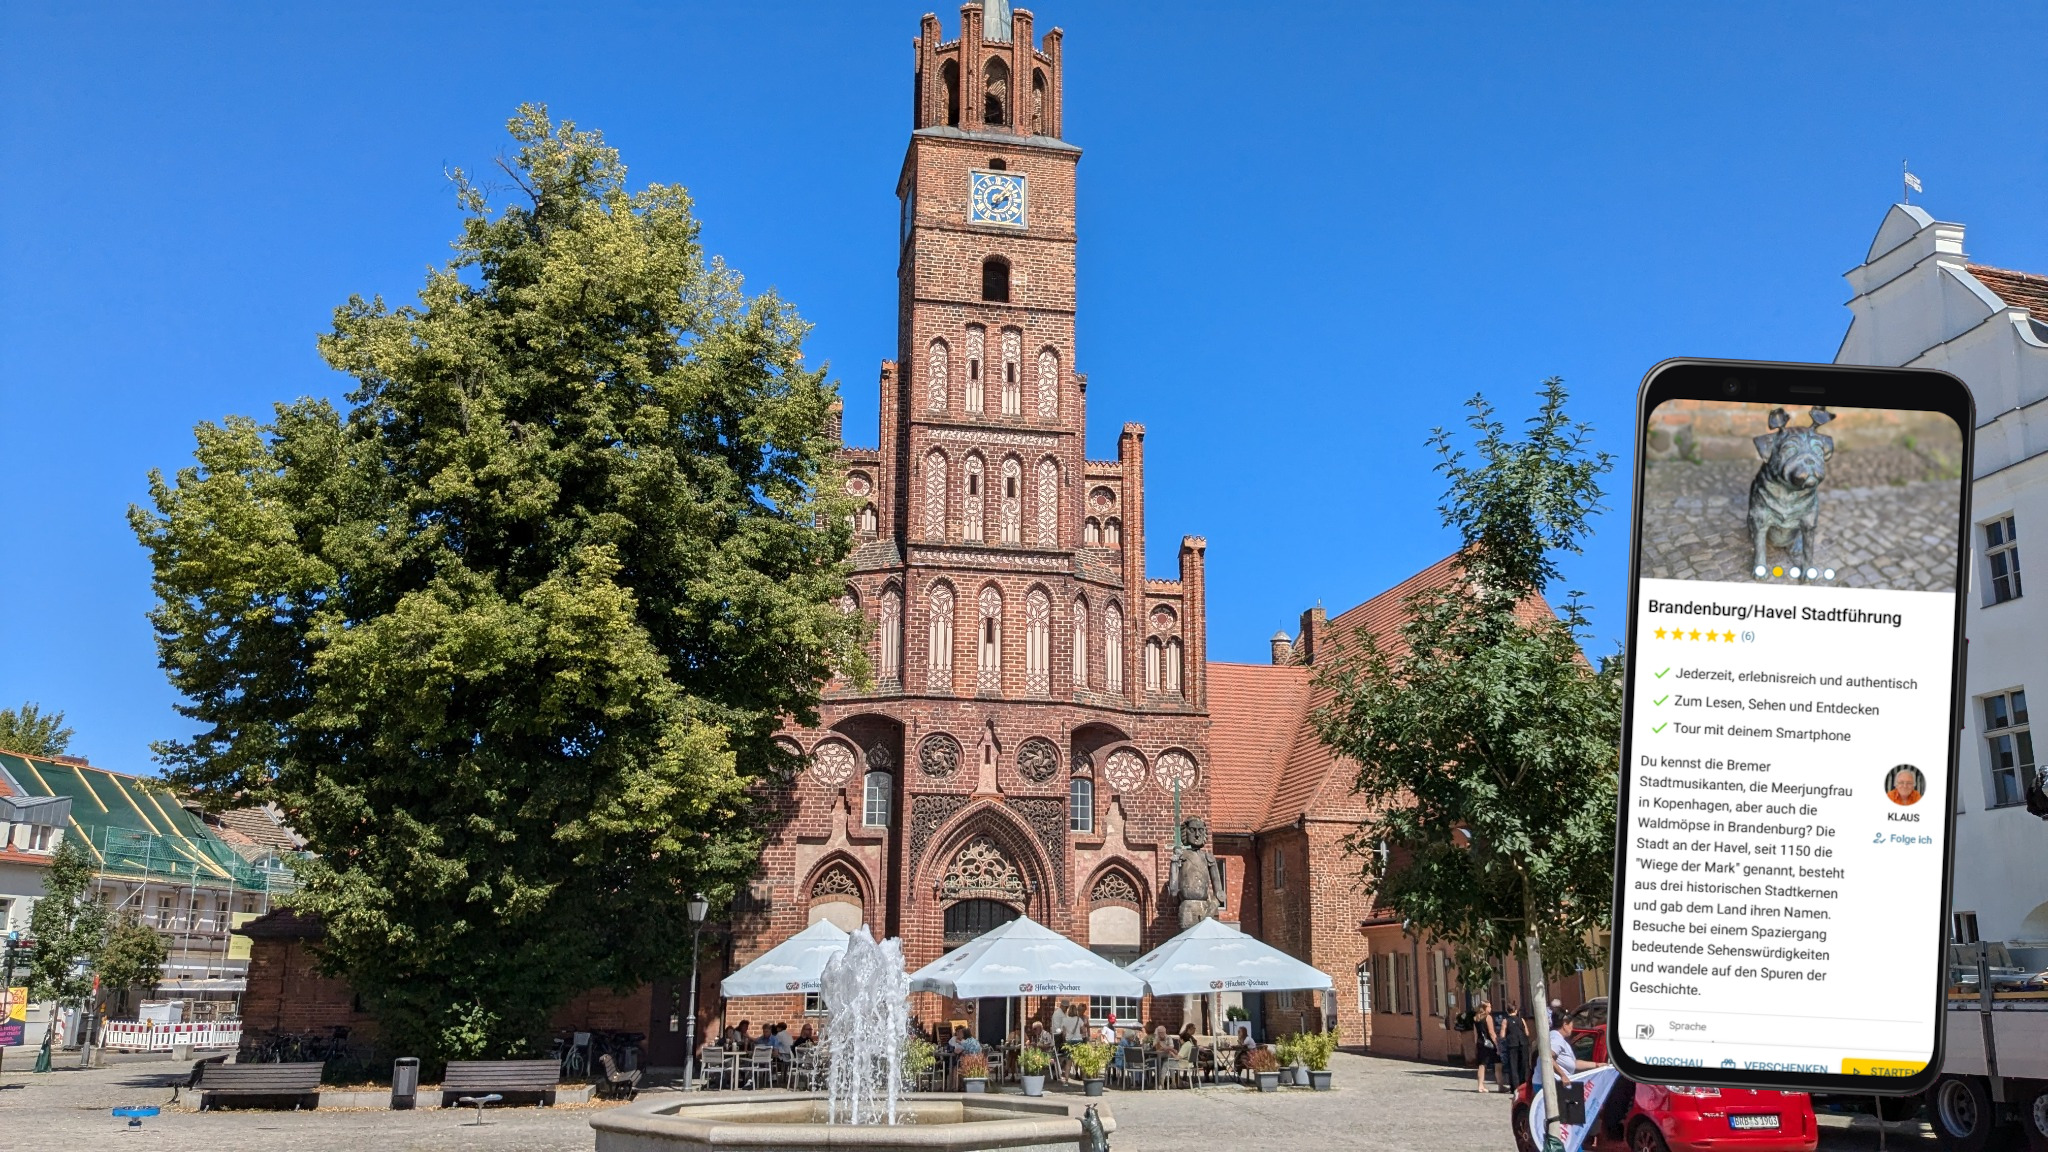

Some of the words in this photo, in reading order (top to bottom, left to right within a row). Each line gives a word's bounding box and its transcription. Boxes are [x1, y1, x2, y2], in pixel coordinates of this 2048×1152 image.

[1648, 598, 1797, 621] Brandenburg/Havel
[1800, 606, 1902, 629] Stadtführung
[1741, 631, 1756, 643] (6)
[1675, 667, 1735, 683] Jederzeit,
[1737, 670, 1817, 685] erlebnisreich
[1819, 674, 1843, 687] und
[1845, 676, 1918, 690] authentisch
[1674, 694, 1703, 708] Zum
[1705, 696, 1745, 711] Lesen,
[1747, 697, 1787, 712] Sehen
[1789, 700, 1813, 713] und
[1816, 701, 1880, 716] Entdecken
[1673, 721, 1702, 735] Tour
[1703, 724, 1725, 736] mit
[1727, 724, 1773, 738] deinem
[1775, 726, 1852, 743] Smartphone
[1640, 754, 1658, 767] Du
[1660, 755, 1702, 770] kennst
[1704, 757, 1724, 771] die
[1726, 758, 1772, 773] Bremer
[1639, 775, 1746, 794] Stadtmusikanten,
[1749, 780, 1769, 793] die
[1771, 781, 1853, 799] Meerjungfrau
[1638, 795, 1650, 808] in
[1653, 796, 1733, 814] Kopenhagen,
[1735, 800, 1764, 814] aber
[1765, 802, 1796, 815] auch
[1798, 803, 1818, 816] die
[1637, 816, 1711, 833] Waldmöpse
[1713, 820, 1725, 832] in
[1727, 820, 1813, 839] Brandenburg?
[1815, 825, 1836, 838] Die
[1887, 812, 1921, 823] KLAUS
[1636, 836, 1670, 850] Stadt
[1672, 841, 1688, 851] an
[1690, 839, 1711, 852] der
[1713, 840, 1751, 856] Havel,
[1754, 843, 1777, 856] seit
[1780, 844, 1811, 857] 1150
[1813, 845, 1833, 858] die
[1890, 833, 1917, 846] Folge
[1918, 835, 1933, 845] ich
[1635, 857, 1679, 874] "Wiege
[1680, 859, 1702, 873] der
[1704, 860, 1741, 874] Mark"
[1742, 865, 1796, 878] genannt,
[1798, 865, 1845, 880] besteht
[1634, 880, 1657, 891] aus
[1659, 879, 1684, 892] drei
[1686, 880, 1762, 896] historischen
[1764, 884, 1839, 900] Stadtkernen
[1633, 899, 1657, 912] und
[1659, 900, 1684, 915] gab
[1685, 901, 1714, 914] dem
[1716, 903, 1747, 916] Land
[1750, 904, 1781, 918] ihren
[1783, 906, 1831, 920] Namen.
[1632, 919, 1686, 934] Besuche
[1688, 921, 1707, 935] bei
[1709, 923, 1748, 936] einem
[1751, 925, 1827, 943] Spaziergang
[1631, 939, 1704, 955] bedeutende
[1706, 943, 1830, 962] Sehenswürdigkeiten
[1630, 961, 1655, 974] und
[1656, 963, 1709, 976] wandele
[1711, 964, 1732, 977] auf
[1734, 965, 1758, 979] den
[1760, 966, 1804, 981] Spuren
[1806, 968, 1828, 982] der
[1629, 981, 1702, 996] Geschichte.
[1669, 1020, 1707, 1031] Sprache
[1643, 1056, 1704, 1068] VORSCHAU
[1743, 1061, 1829, 1074] VERSCHENKEN
